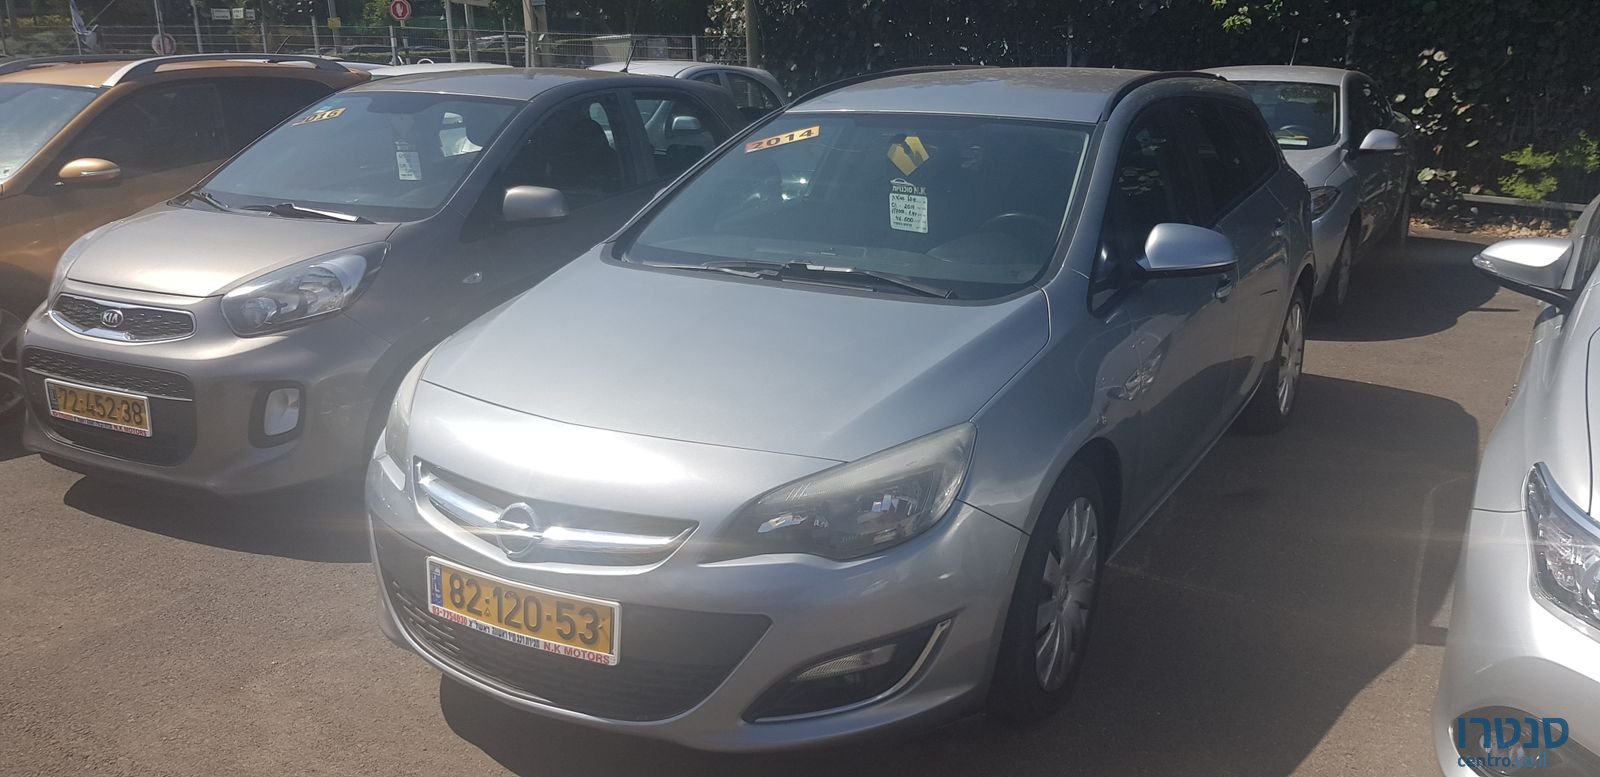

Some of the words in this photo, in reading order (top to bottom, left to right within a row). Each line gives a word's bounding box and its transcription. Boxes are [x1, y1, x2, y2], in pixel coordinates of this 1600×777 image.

[748, 129, 814, 149] 2014
[103, 311, 119, 324] KIA
[543, 641, 561, 653] N.K
[564, 647, 610, 665] MOTORS
